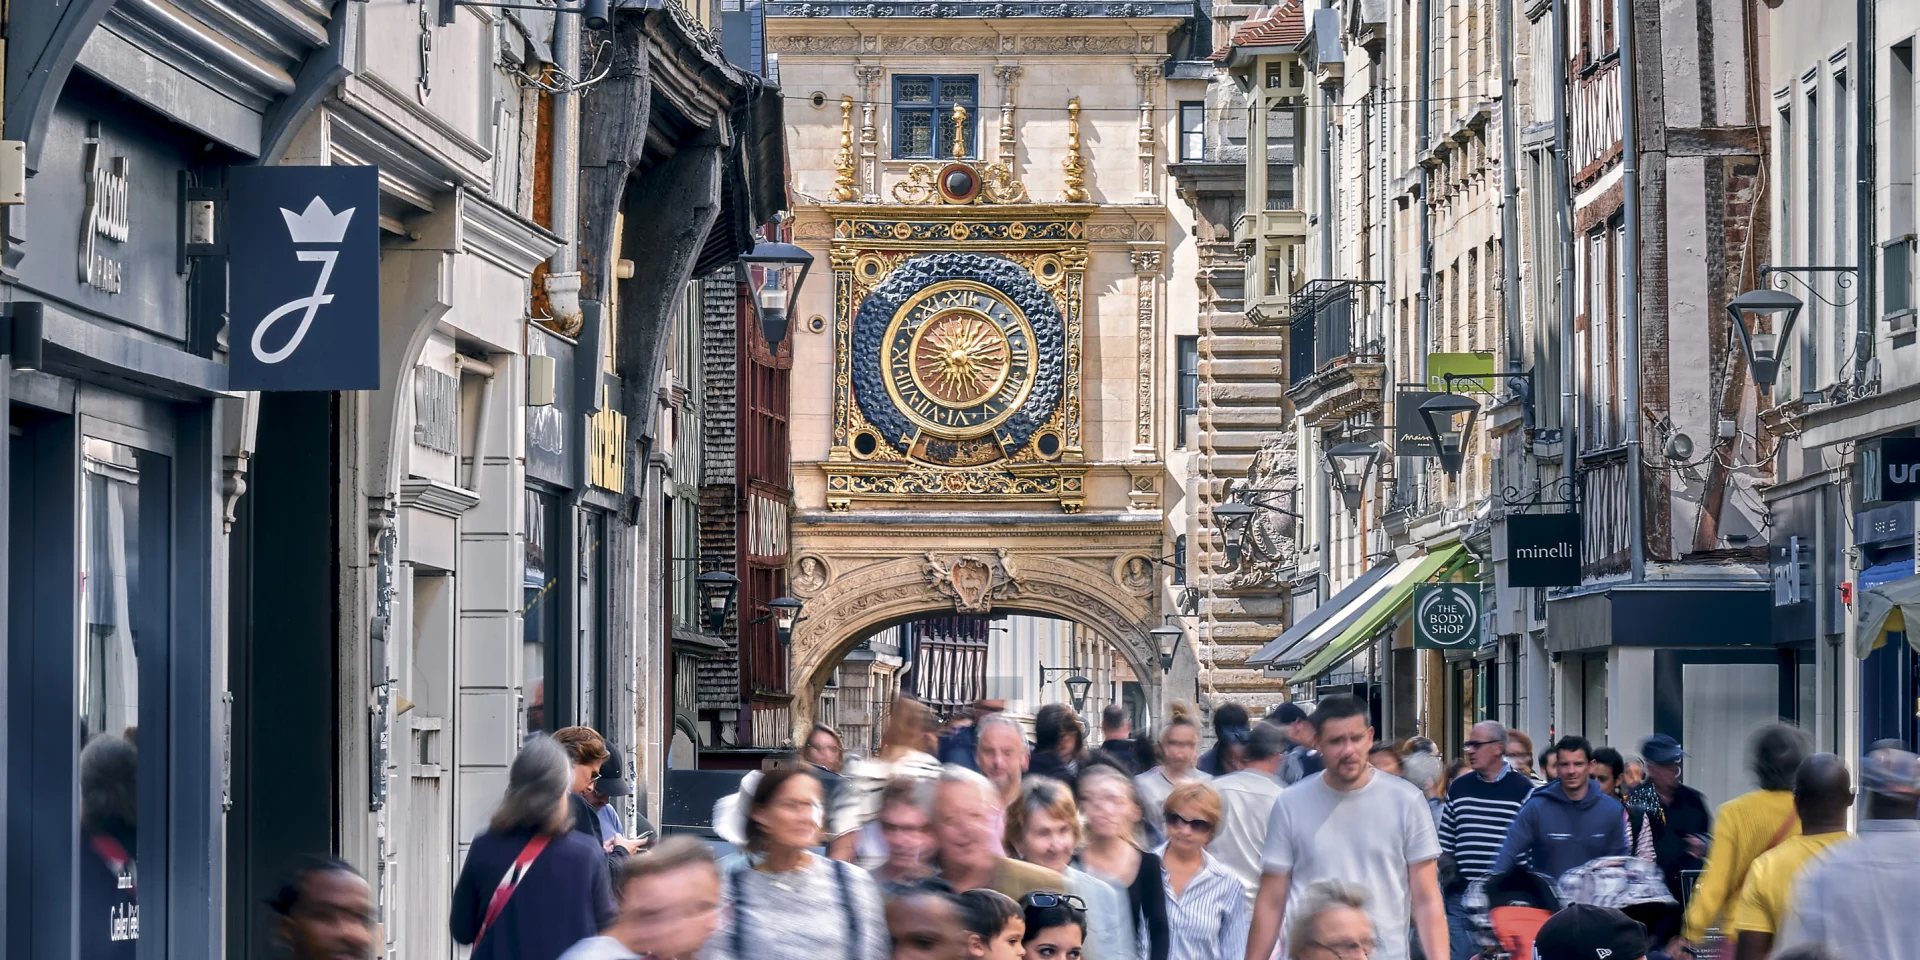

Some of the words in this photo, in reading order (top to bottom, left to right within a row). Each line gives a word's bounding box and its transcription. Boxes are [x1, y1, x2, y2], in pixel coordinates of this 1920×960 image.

[96, 254, 122, 295] PARIS
[1516, 542, 1573, 559] minelli
[1437, 604, 1457, 614] THE
[1430, 614, 1465, 624] BODY
[1431, 624, 1464, 634] SHOP
